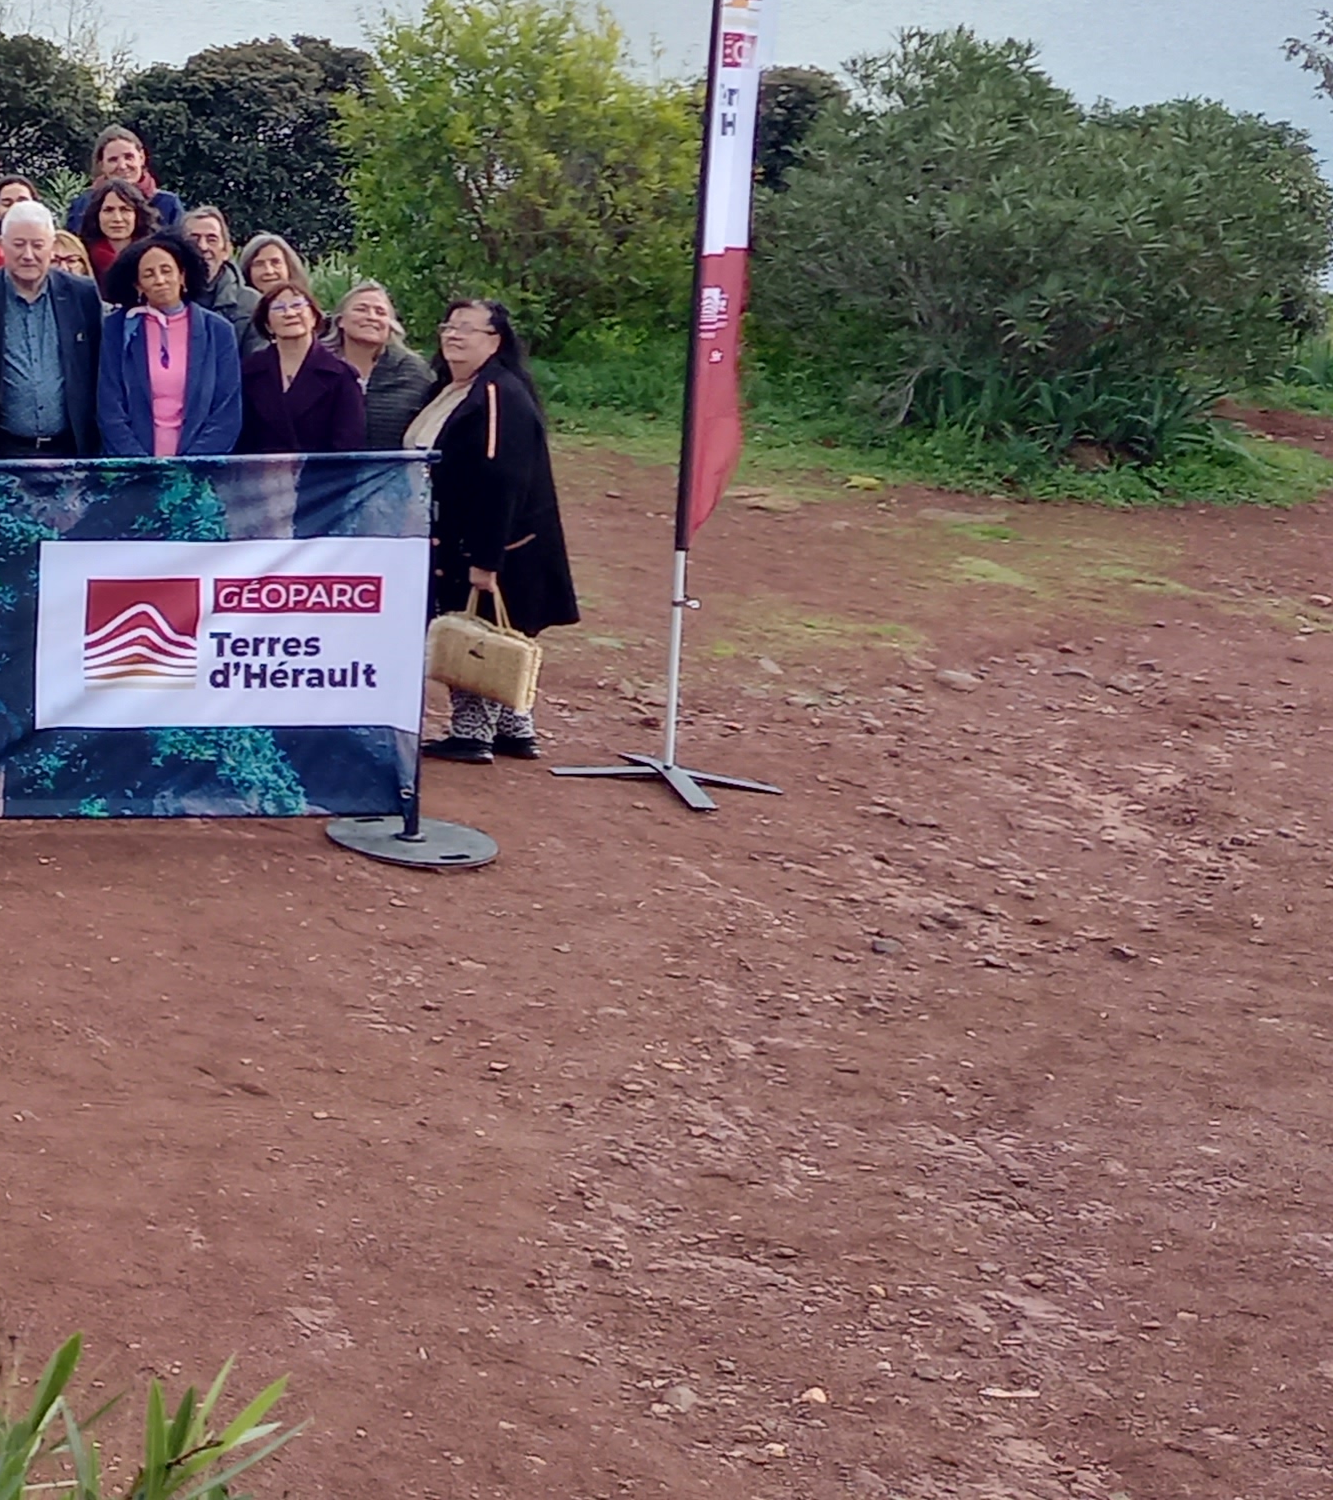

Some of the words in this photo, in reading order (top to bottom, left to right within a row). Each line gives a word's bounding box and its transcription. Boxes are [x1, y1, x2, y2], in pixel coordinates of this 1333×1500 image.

[218, 580, 376, 608] GÉOPARC
[209, 632, 322, 658] Terres
[209, 661, 377, 689] d’Hérault
